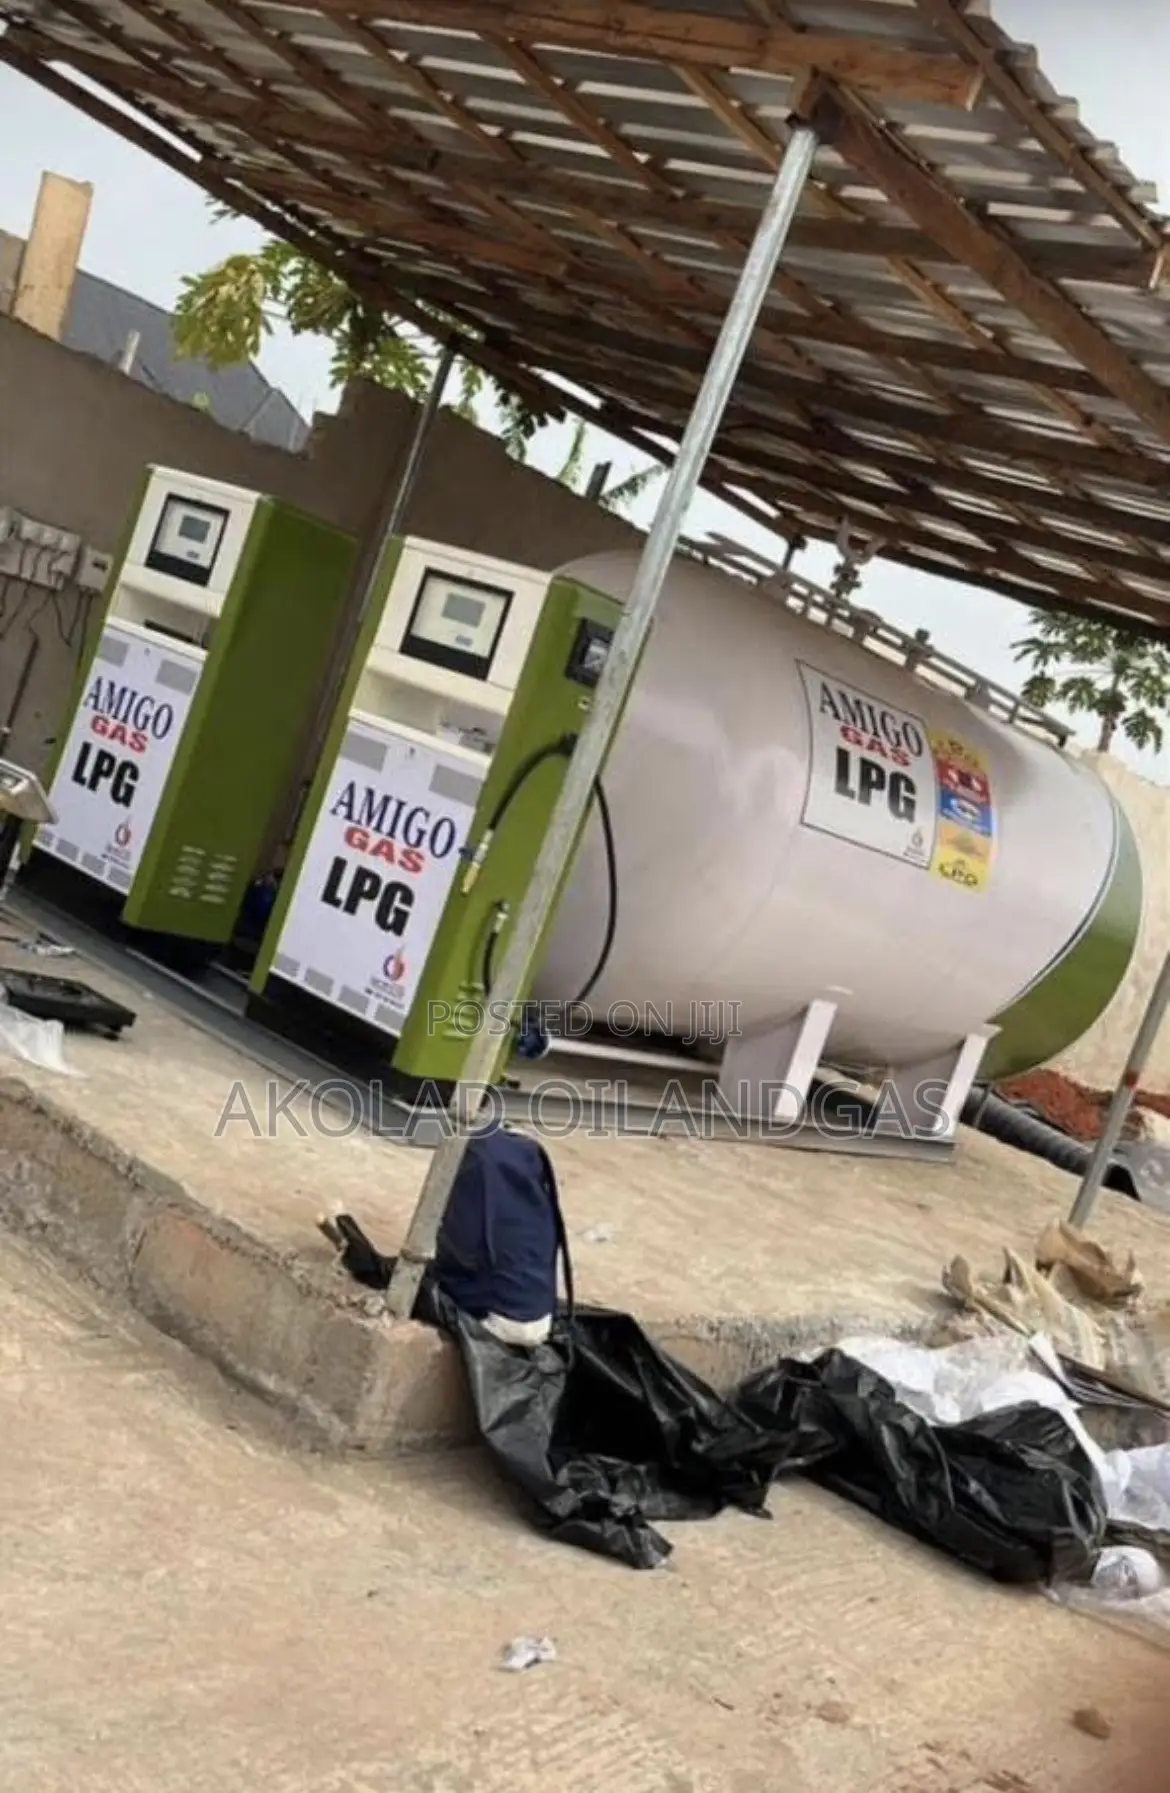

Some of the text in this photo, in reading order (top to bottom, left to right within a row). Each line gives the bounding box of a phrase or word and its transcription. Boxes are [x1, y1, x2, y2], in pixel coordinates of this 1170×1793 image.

[83, 676, 174, 740] AMIGO
[91, 715, 149, 754] GAS
[819, 682, 924, 758] AMIGO
[71, 741, 140, 809] LPG
[840, 725, 911, 767] GAS
[834, 745, 917, 823] LPG
[330, 781, 456, 859] AMIGO
[344, 827, 426, 874] GAS
[320, 856, 415, 937] LPG
